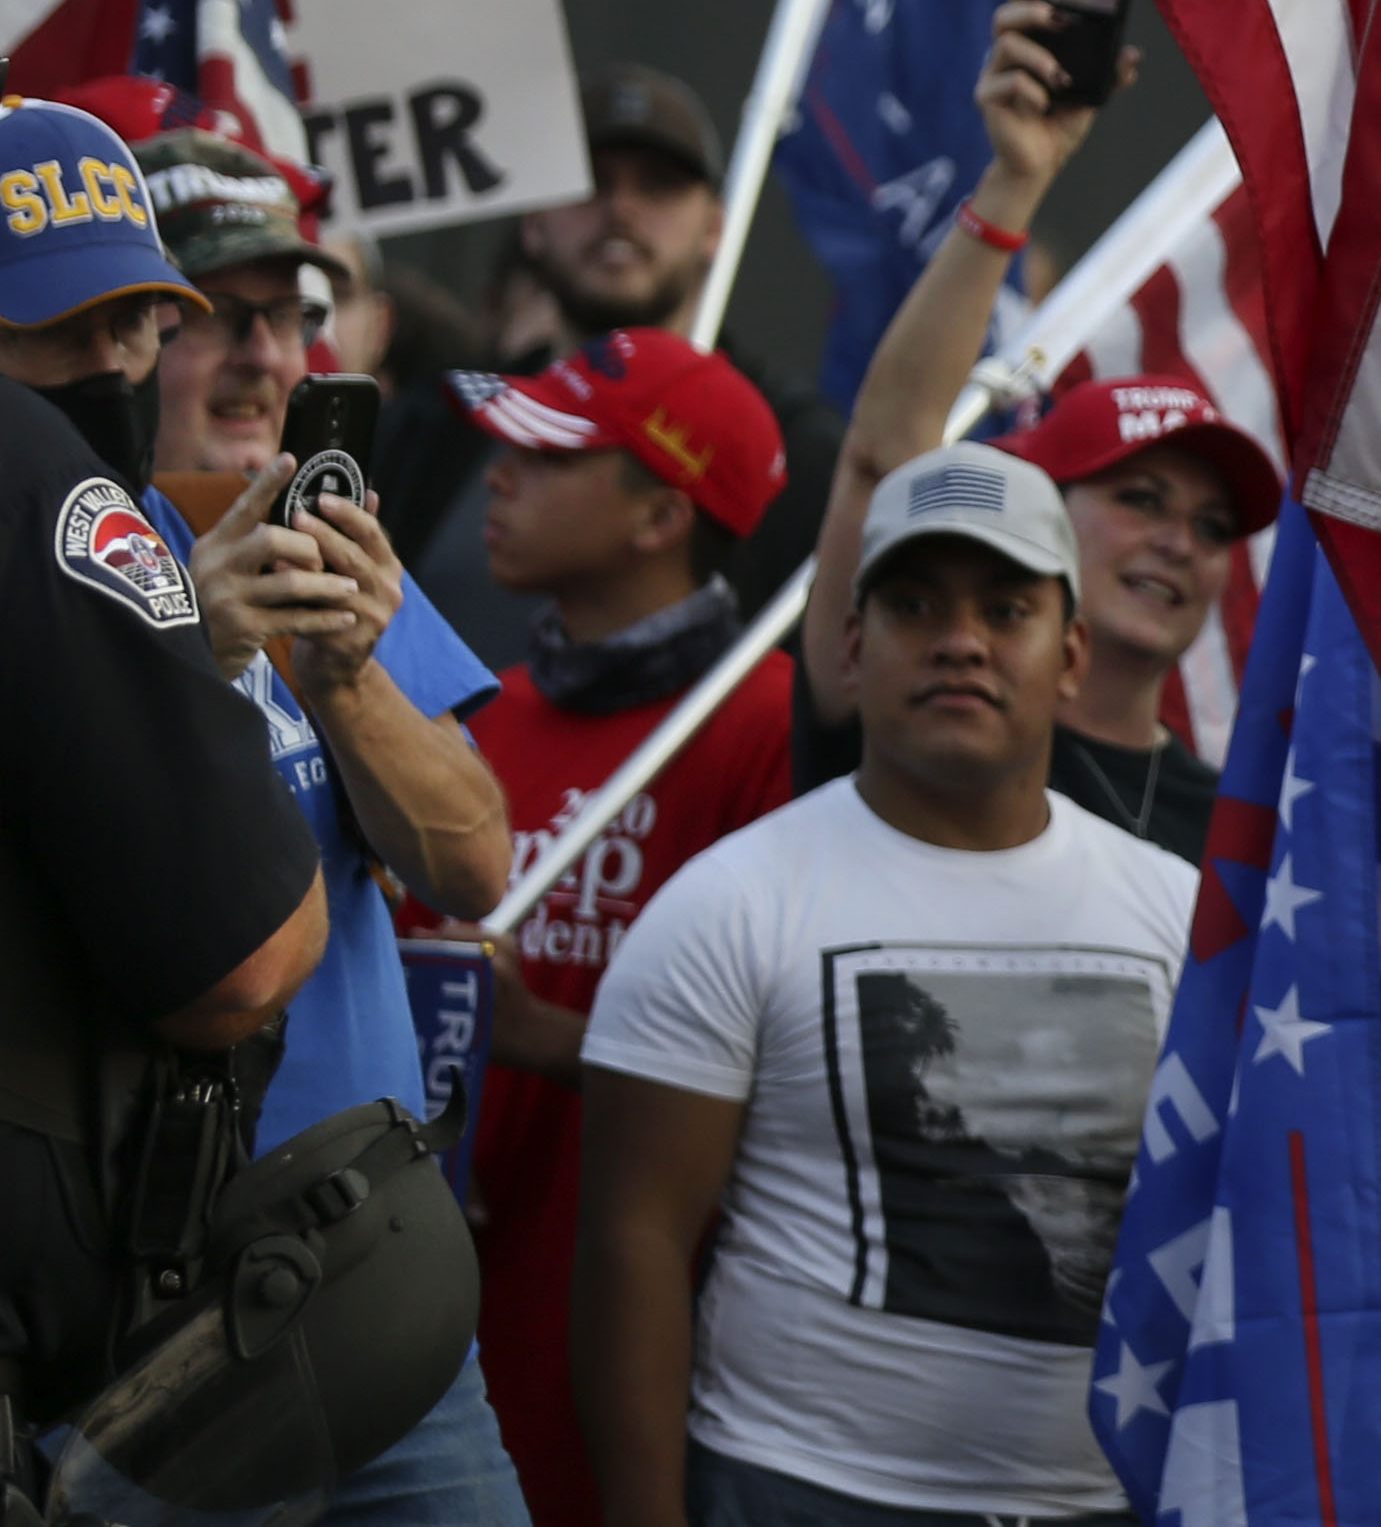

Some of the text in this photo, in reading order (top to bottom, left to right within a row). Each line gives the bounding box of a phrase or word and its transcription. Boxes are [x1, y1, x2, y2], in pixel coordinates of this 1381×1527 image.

[0, 155, 148, 236] SLCC
[64, 504, 94, 558] WEST
[148, 592, 193, 619] POLICE
